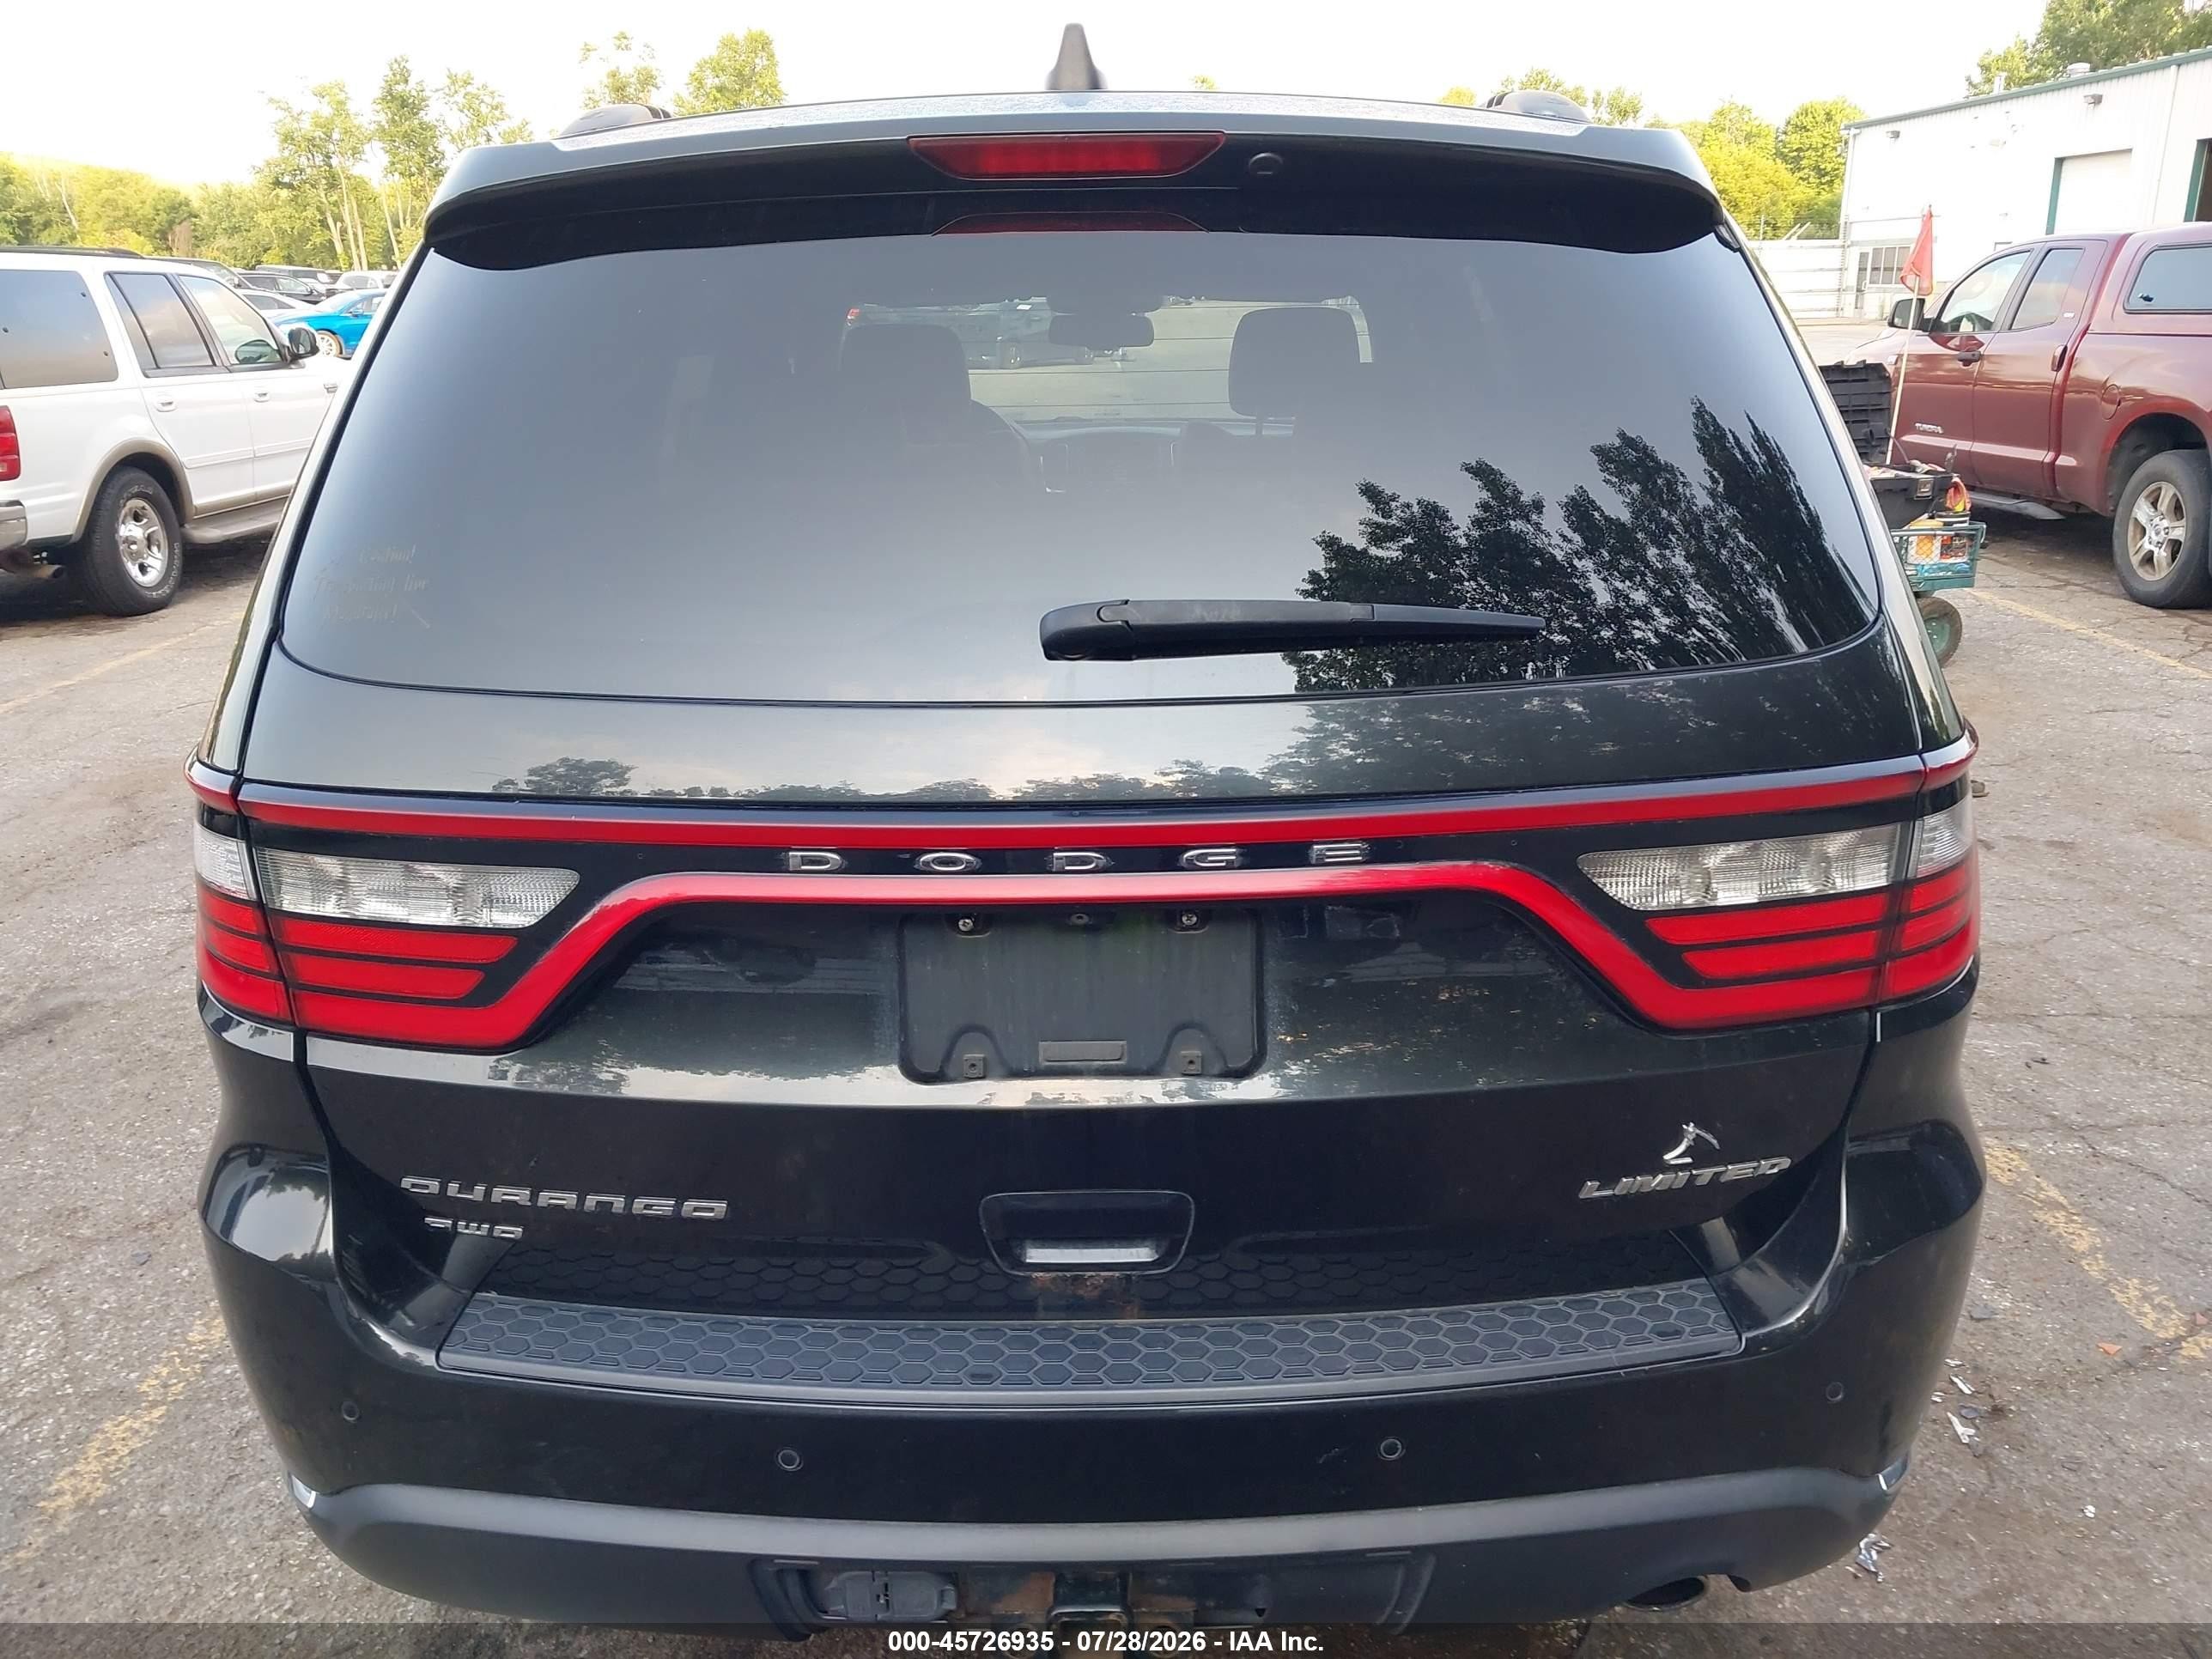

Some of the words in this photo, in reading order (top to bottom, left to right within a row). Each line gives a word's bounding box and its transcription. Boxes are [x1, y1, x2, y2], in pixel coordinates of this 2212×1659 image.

[787, 842, 1370, 872] DODGE
[1578, 1157, 1792, 1199] LIMITED
[400, 1176, 729, 1219] DURANGO
[424, 1217, 524, 1239] AWD
